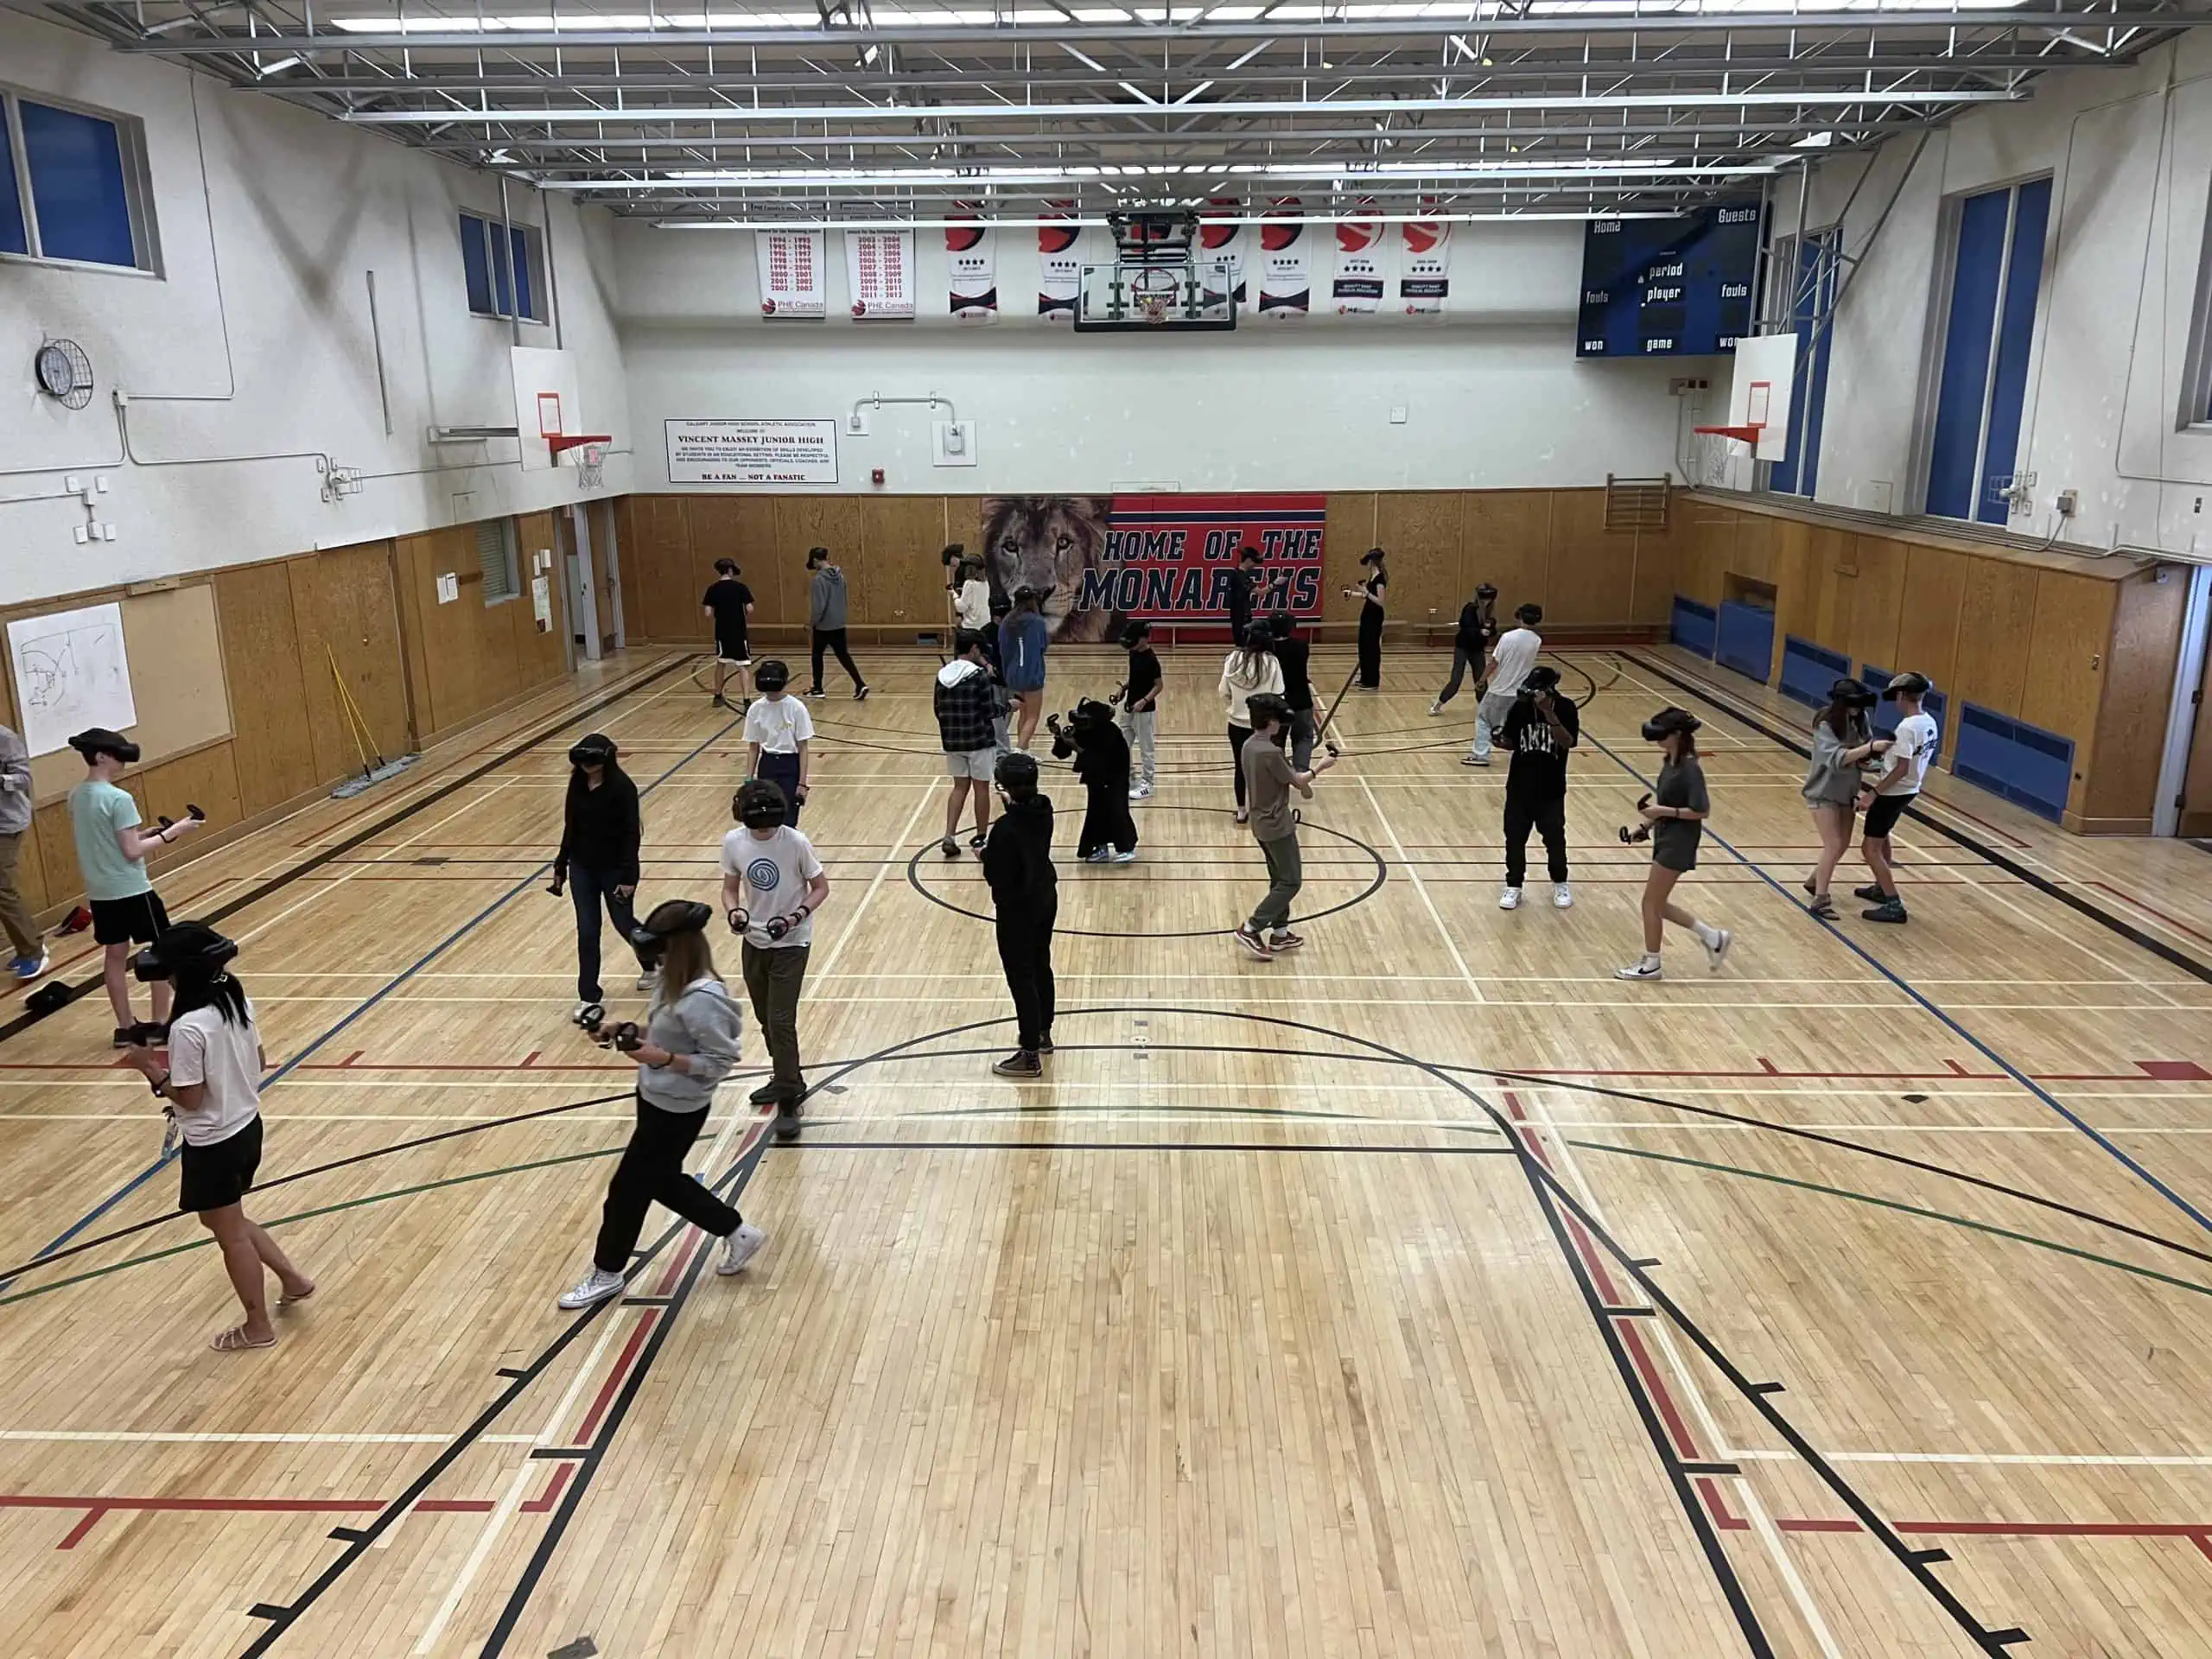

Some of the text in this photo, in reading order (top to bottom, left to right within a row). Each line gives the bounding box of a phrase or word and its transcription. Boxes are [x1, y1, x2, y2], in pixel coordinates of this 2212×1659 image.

[1718, 208, 1757, 224] Guests
[1593, 220, 1622, 234] Home
[1649, 262, 1683, 281] period
[1586, 289, 1609, 304] fouls
[1647, 286, 1681, 302] player
[1720, 283, 1747, 298] fouls
[1585, 340, 1604, 352] won
[1646, 338, 1673, 353] game
[761, 435, 795, 445] JUNIOR
[1102, 528, 1324, 562] HOME OF THE
